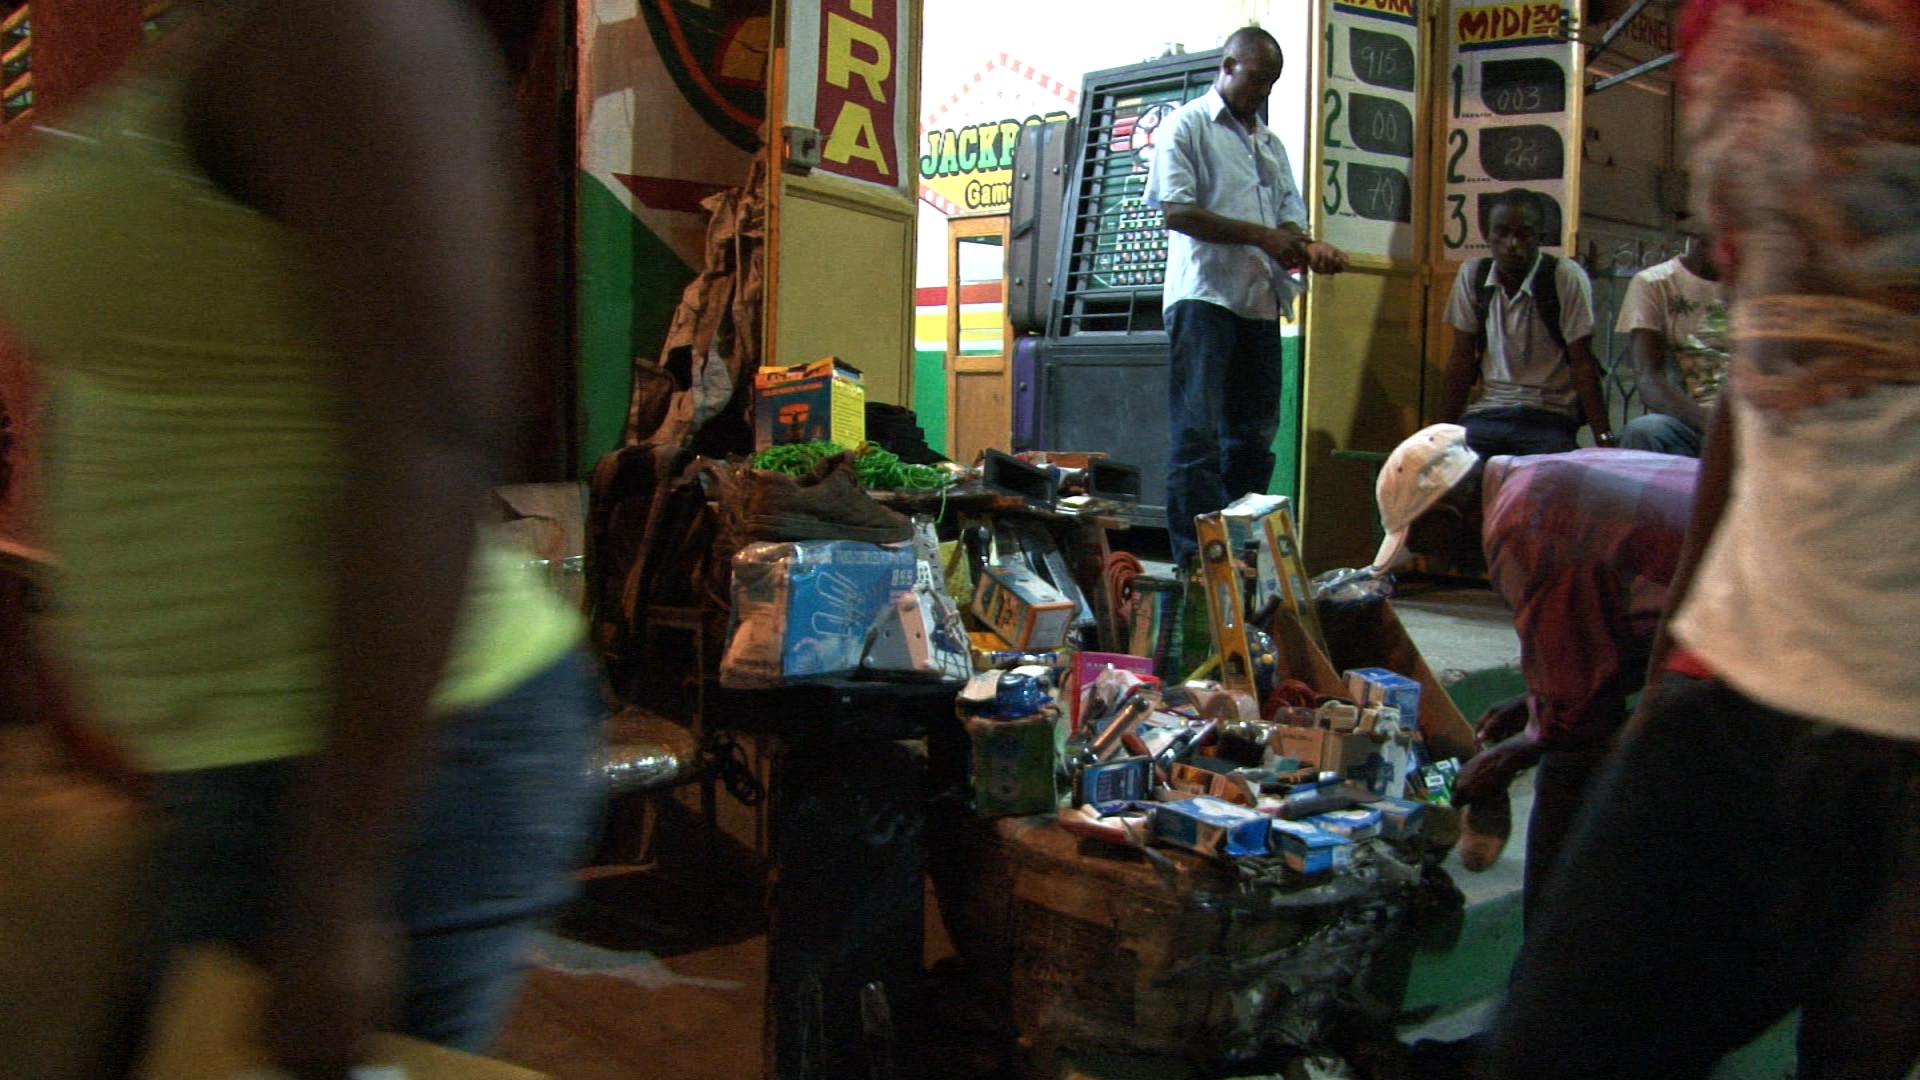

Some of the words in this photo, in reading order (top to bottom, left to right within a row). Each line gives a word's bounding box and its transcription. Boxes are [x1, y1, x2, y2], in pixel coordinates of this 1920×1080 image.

[1458, 4, 1532, 41] MIDI
[1325, 23, 1334, 79] 1
[1361, 46, 1399, 80] 915
[822, 0, 892, 175] RA
[1452, 63, 1463, 119] 1
[1497, 85, 1541, 112] 003
[920, 111, 1070, 180] JACKP
[1324, 88, 1342, 148] 2
[1372, 111, 1397, 142] 00
[1447, 128, 1468, 184] 2
[1322, 158, 1342, 216] 3
[1367, 170, 1394, 212] 70
[1443, 193, 1468, 249] 3
